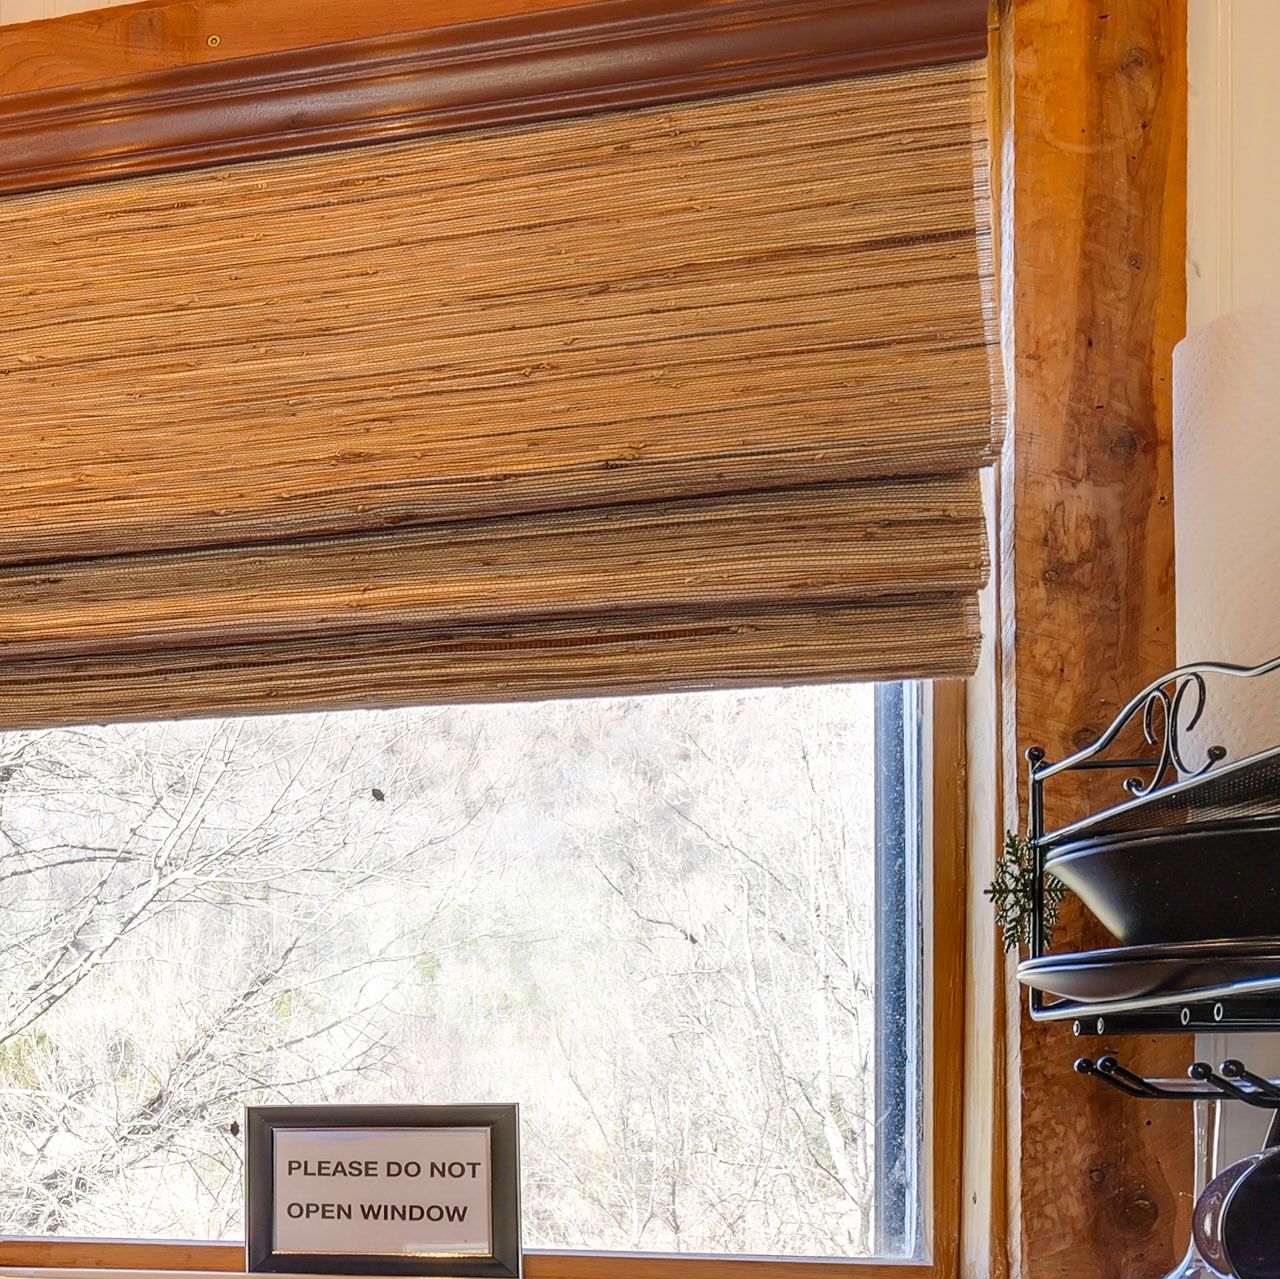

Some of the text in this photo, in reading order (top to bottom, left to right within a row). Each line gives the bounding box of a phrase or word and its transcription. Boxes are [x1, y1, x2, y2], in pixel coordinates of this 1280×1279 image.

[288, 1160, 482, 1178] PLEASE DO NOT
[287, 1202, 468, 1222] OPEN WINDOW
